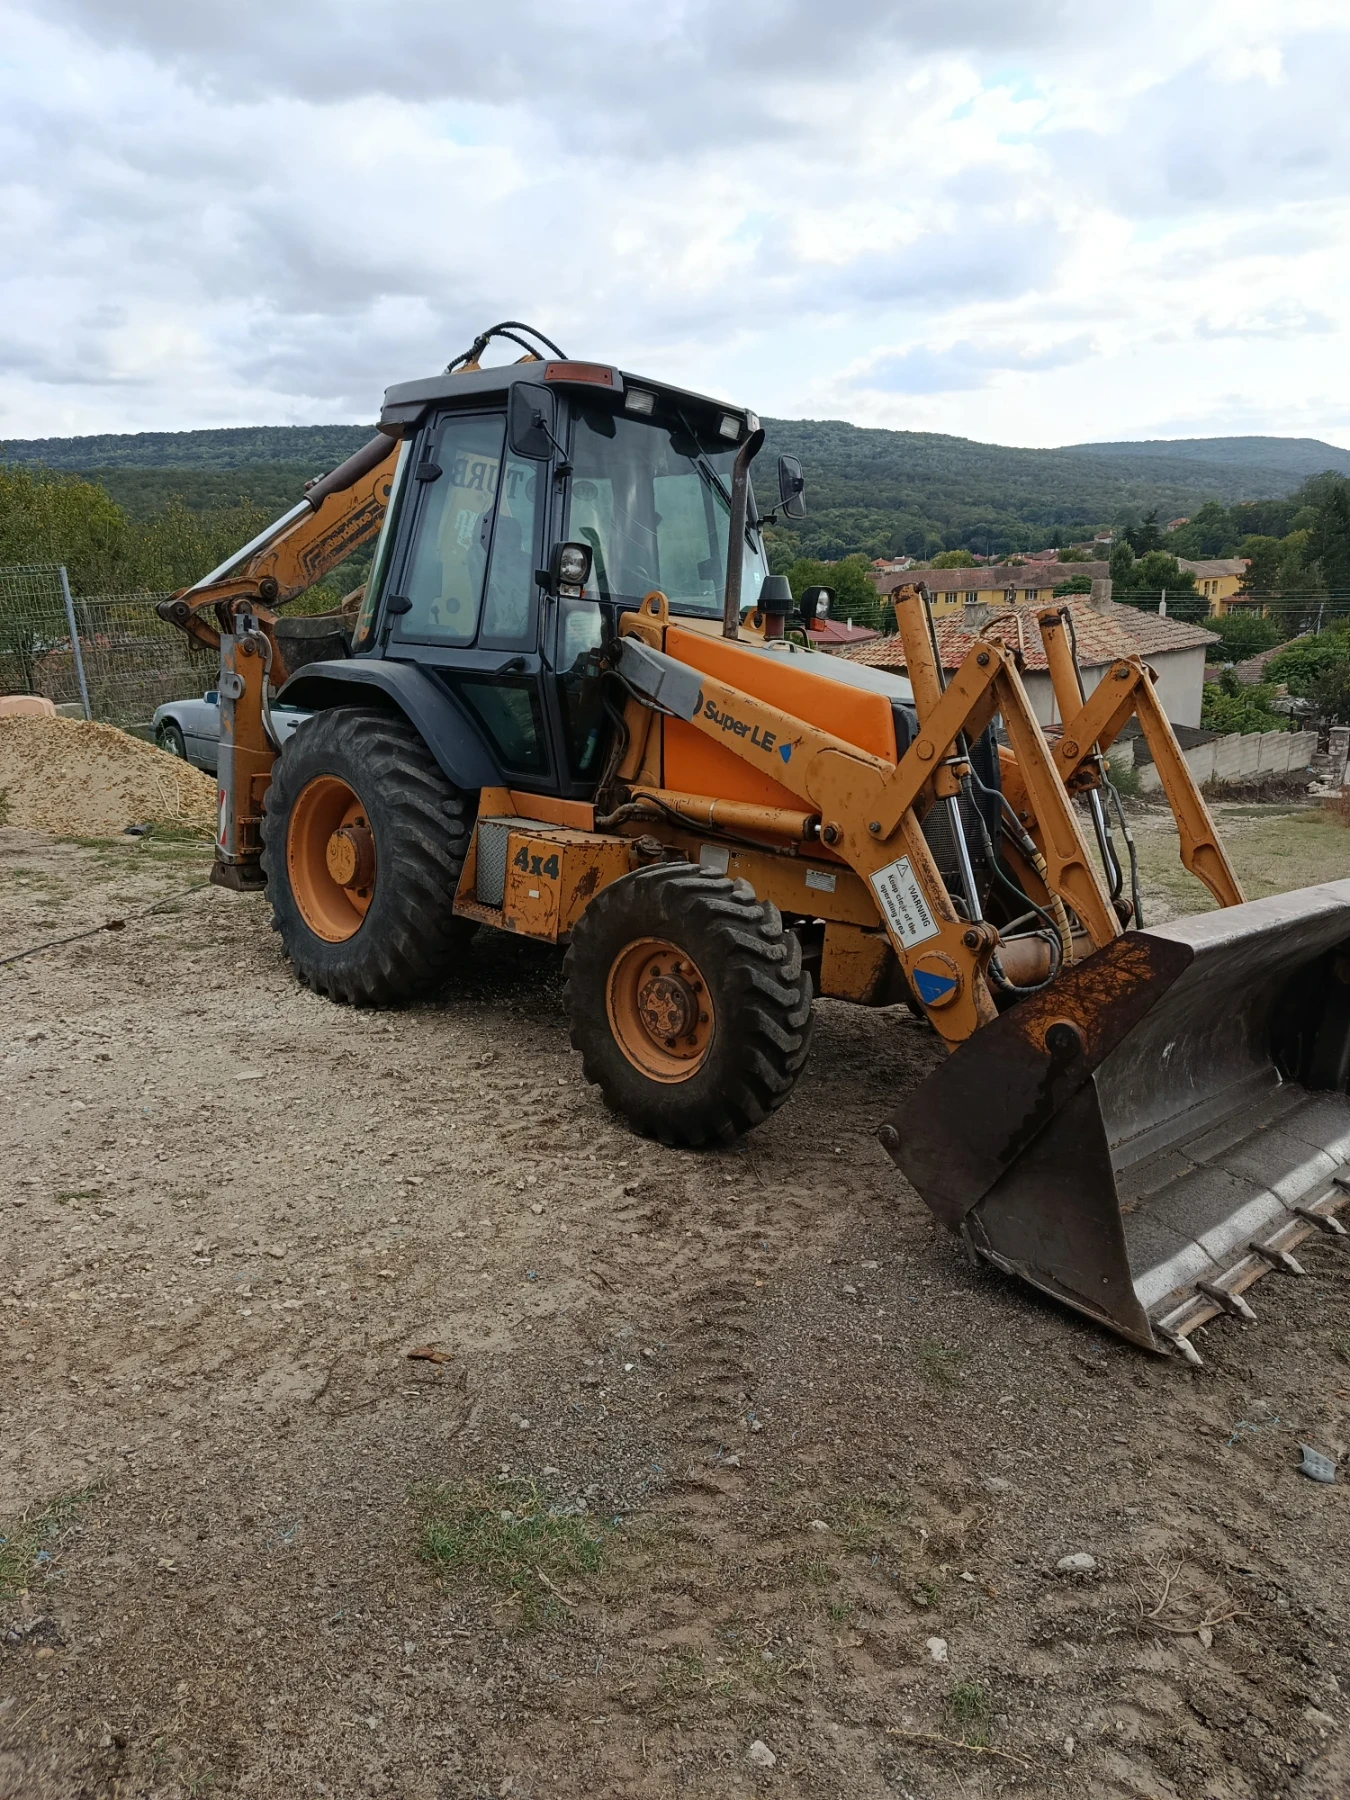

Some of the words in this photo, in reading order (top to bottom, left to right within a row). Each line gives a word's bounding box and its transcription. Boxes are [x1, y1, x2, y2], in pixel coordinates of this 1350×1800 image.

[703, 700, 751, 738] Super
[750, 725, 777, 753] LE
[513, 846, 560, 880] 4x4
[887, 873, 899, 894] Keep
[880, 884, 898, 918] operating
[894, 918, 906, 936] area
[895, 893, 908, 913] clear
[908, 884, 931, 927] WARNING
[903, 913, 913, 922] of
[907, 921, 917, 935] the
